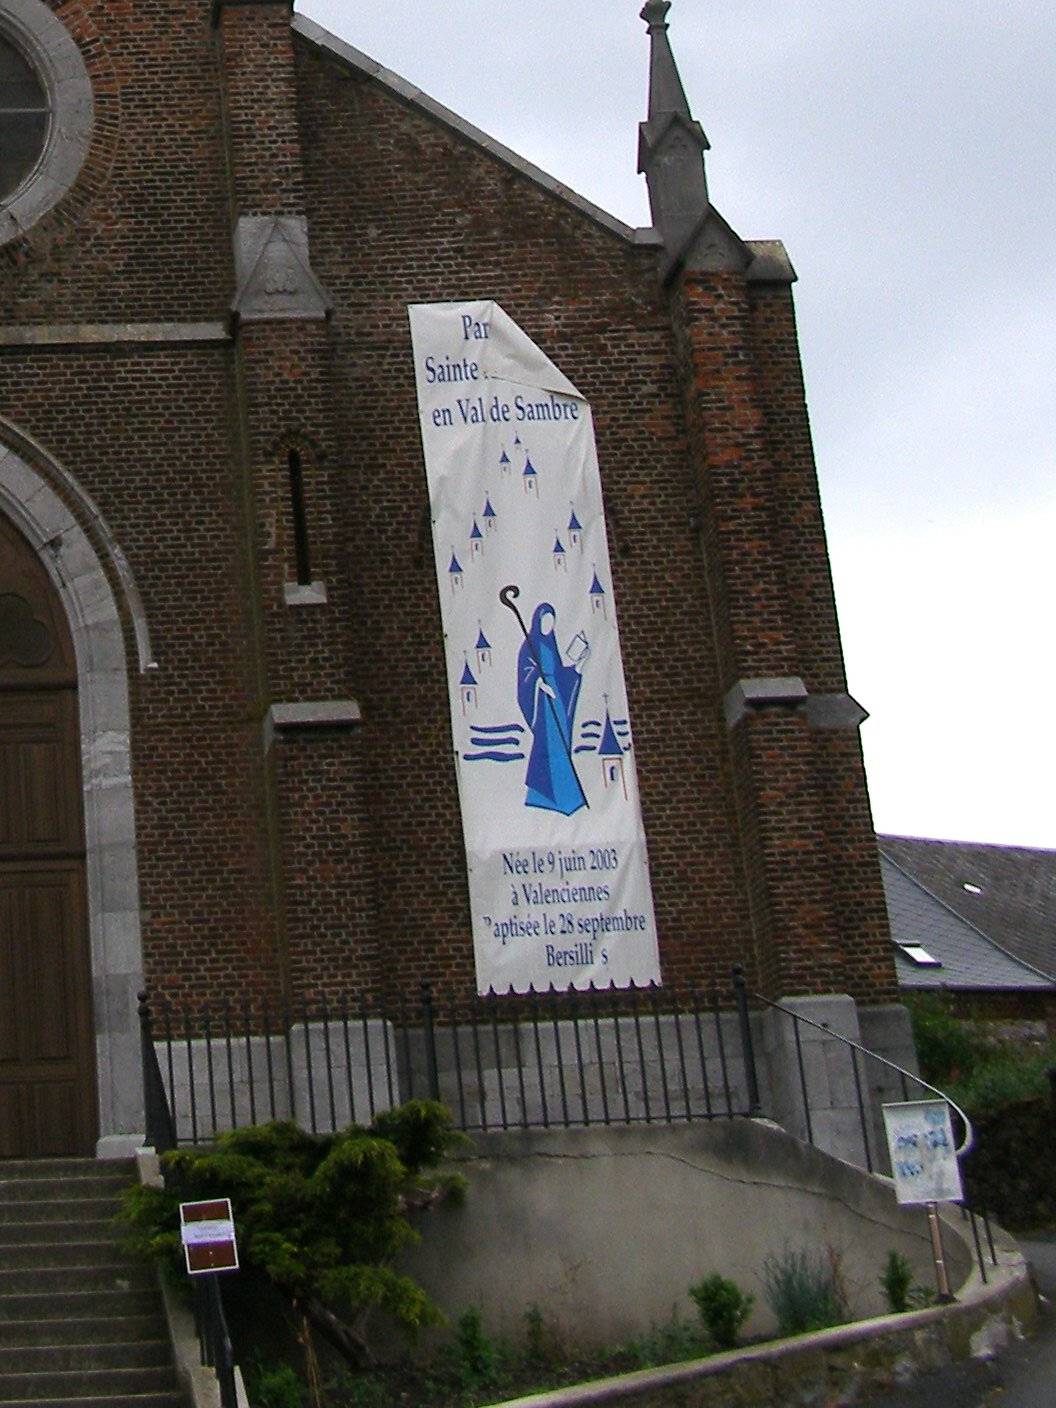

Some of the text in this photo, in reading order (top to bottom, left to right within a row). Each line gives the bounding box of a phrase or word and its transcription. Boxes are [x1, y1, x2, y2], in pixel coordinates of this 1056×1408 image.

[461, 315, 489, 340] Par
[425, 355, 478, 383] Sainte
[432, 395, 579, 427] en Val de Sambre
[502, 848, 618, 879] Née le 9 juin 2003
[511, 881, 610, 906] à Valenciennes
[542, 913, 556, 935] le
[559, 912, 574, 935] 28
[576, 909, 646, 940] septembre
[545, 942, 608, 967] Bersillis
